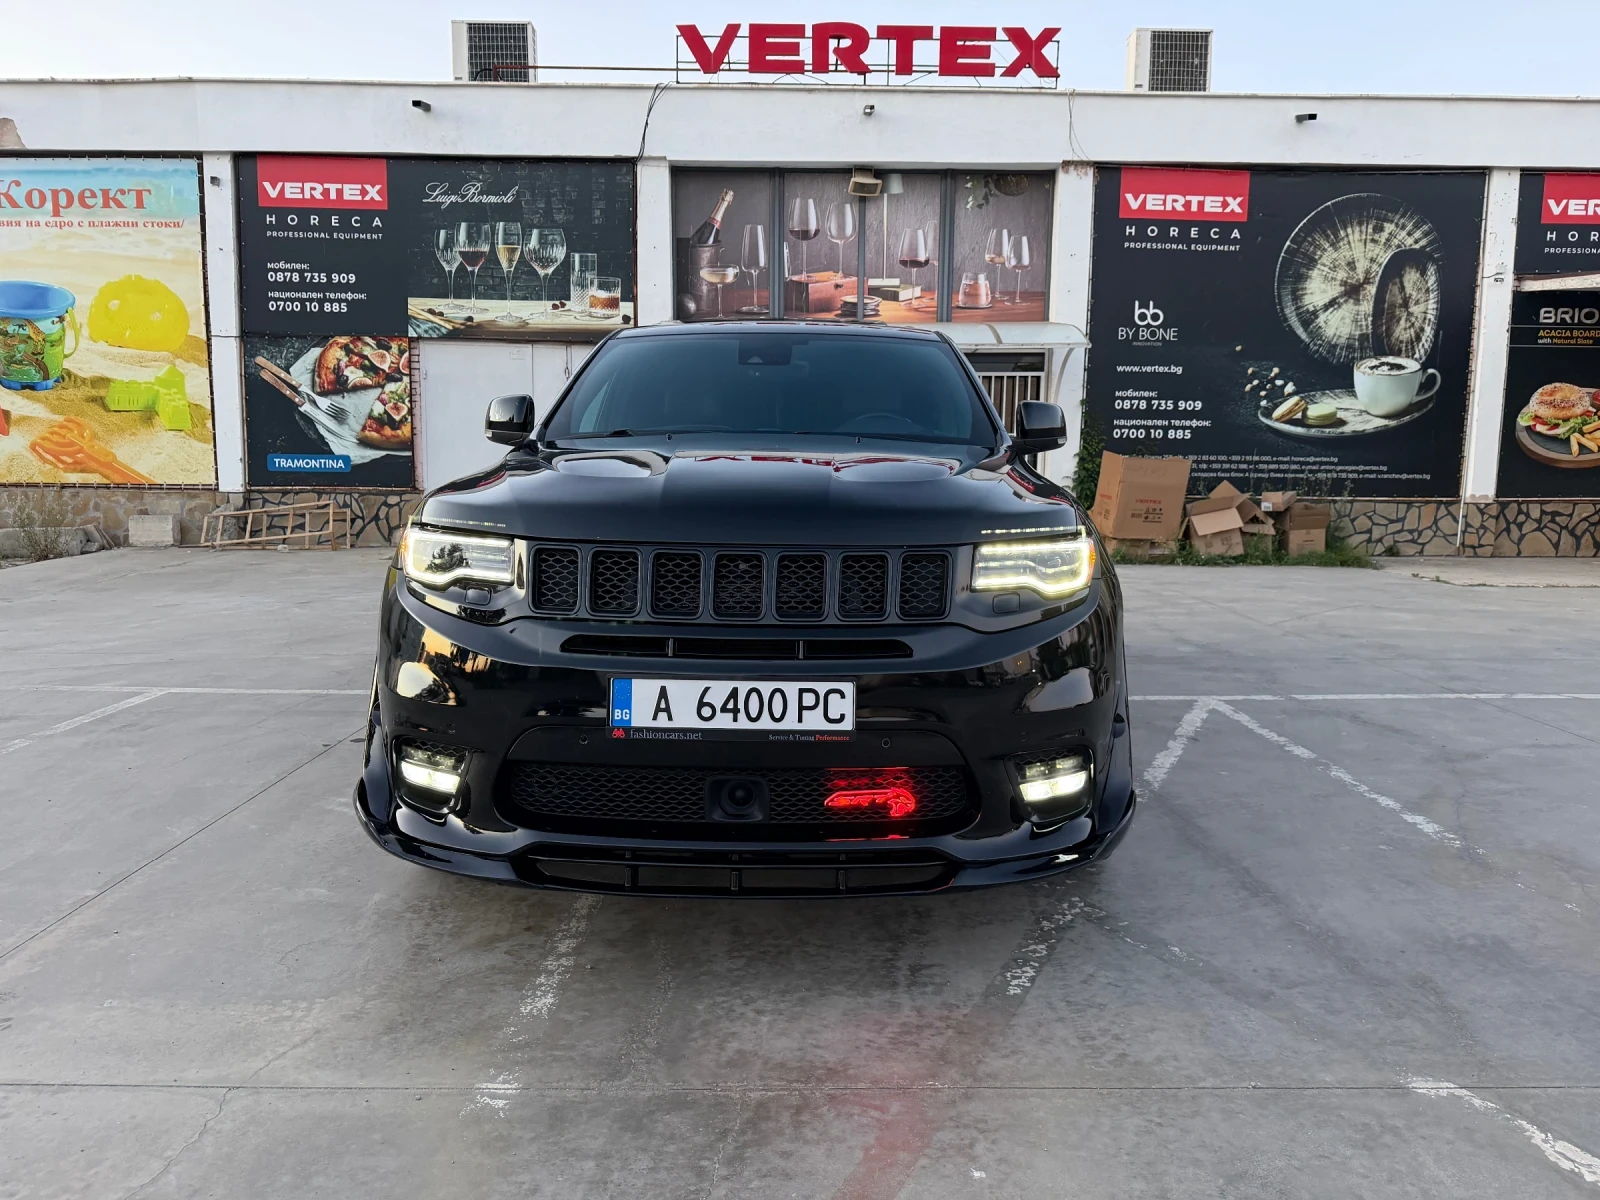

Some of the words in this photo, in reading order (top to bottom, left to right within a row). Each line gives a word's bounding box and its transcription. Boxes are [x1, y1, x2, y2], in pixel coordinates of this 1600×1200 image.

[676, 22, 1062, 78] VERTEX
[262, 181, 383, 201] VERTEX
[422, 182, 462, 209] Luigi
[460, 182, 519, 204] Bormioli
[0, 179, 152, 217] Корект
[1124, 193, 1245, 213] VERTEX
[26, 220, 41, 228] на
[45, 220, 74, 230] едро
[78, 220, 84, 228] с
[88, 220, 140, 229] плажни
[143, 219, 186, 229] стоки/
[265, 214, 383, 228] HORECA
[266, 231, 331, 239] PROFESSIONAL
[333, 232, 383, 240] EQUIPMENT
[1125, 225, 1241, 239] HORECA
[1124, 242, 1189, 250] PROFESSIONAL
[1190, 244, 1241, 252] EQUIPMENT
[267, 261, 310, 271] мобилен:
[267, 272, 301, 283] 0878
[304, 273, 328, 284] 735
[331, 273, 357, 284] 909
[268, 291, 324, 300] национален
[325, 291, 367, 302] телефон:
[268, 301, 301, 312] 0700
[305, 302, 319, 312] 10
[323, 302, 348, 313] 885
[1134, 300, 1164, 326] bb
[1539, 307, 1600, 324] BRIO
[1118, 327, 1136, 340] BY
[1139, 327, 1179, 341] BONE
[1538, 329, 1571, 337] ACACIA
[1116, 364, 1184, 375] www.vertex.bg
[1115, 388, 1158, 398] мобилен:
[1114, 400, 1147, 410] 0878
[1151, 400, 1174, 410] 735
[1177, 400, 1203, 411] 909
[1113, 418, 1169, 428] национален
[1170, 418, 1212, 429] телефон:
[1113, 428, 1146, 439] 0700
[1150, 429, 1164, 439] 10
[1167, 429, 1192, 440] 885
[274, 458, 345, 469] TRAMONTINA
[614, 709, 630, 720] BG
[651, 685, 674, 722] A
[630, 728, 702, 740] fashioncars.net
